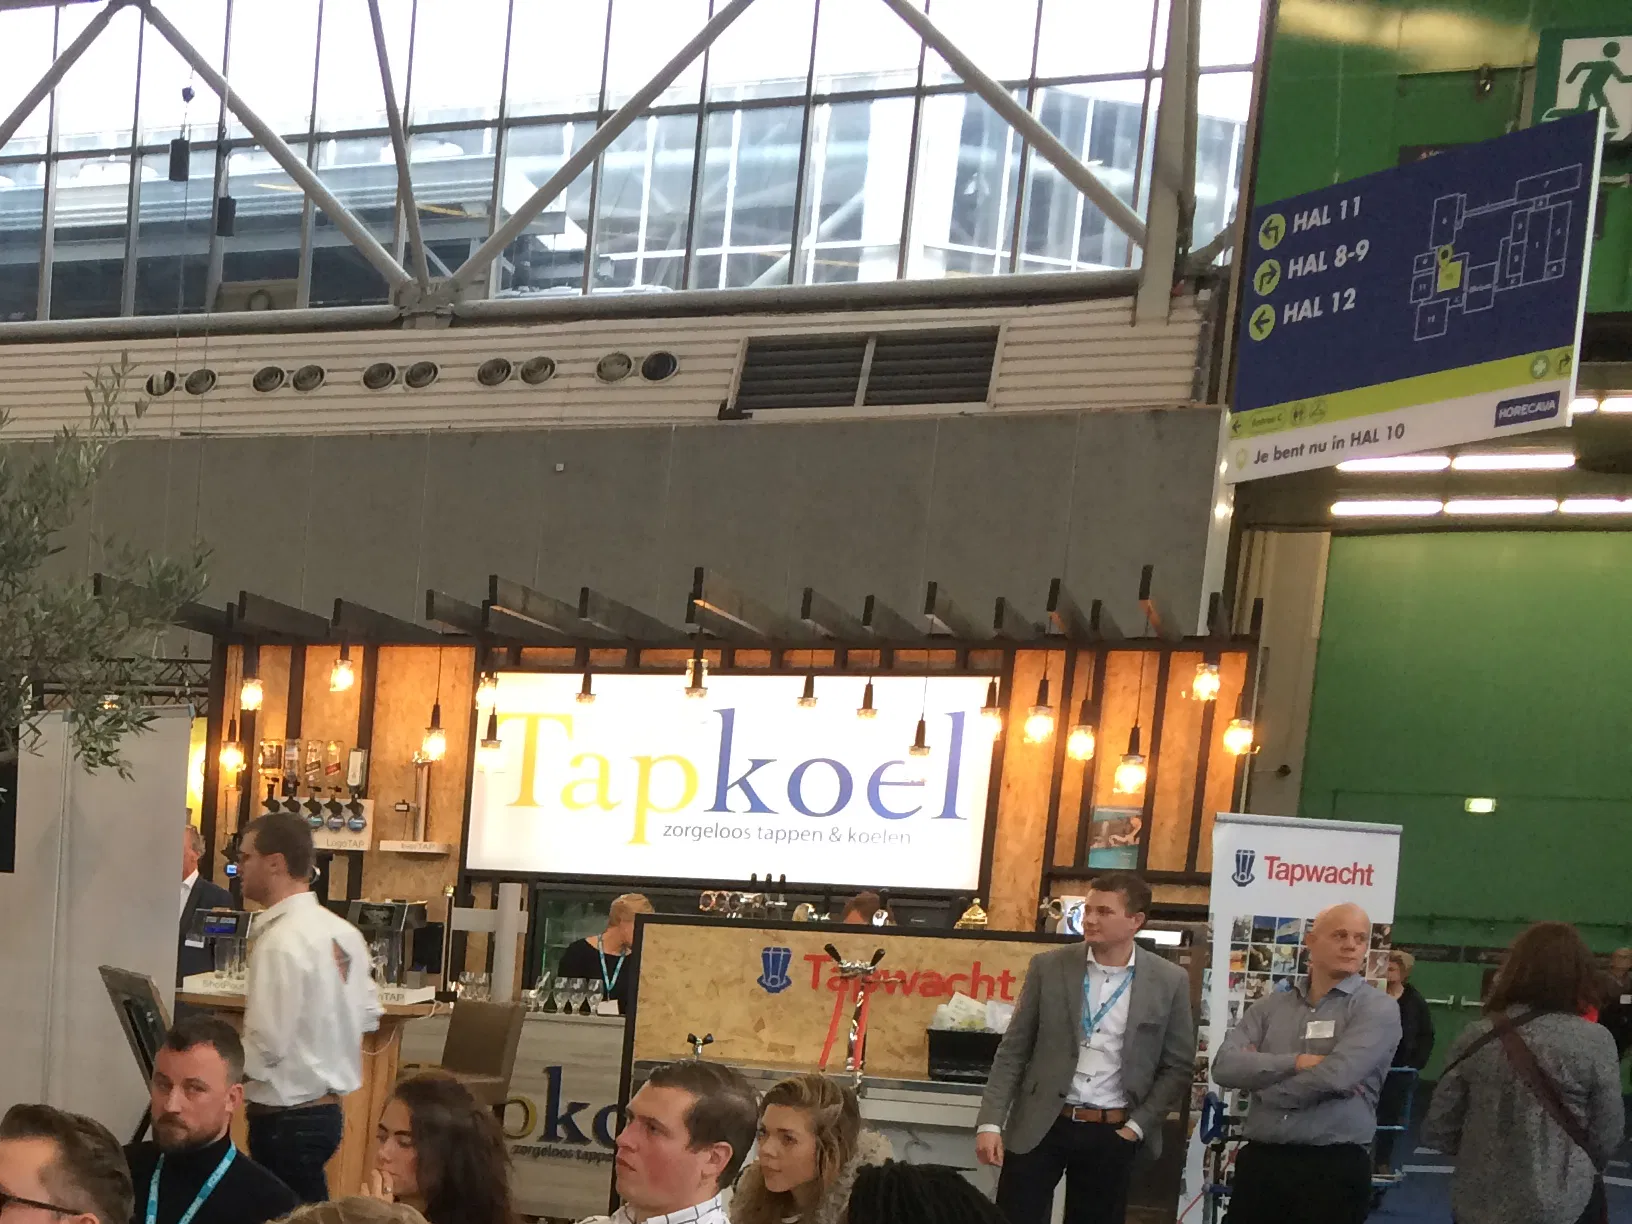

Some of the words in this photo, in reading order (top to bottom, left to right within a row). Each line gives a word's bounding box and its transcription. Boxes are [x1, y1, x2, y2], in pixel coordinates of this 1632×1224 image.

[1292, 204, 1331, 233] HAL
[1340, 196, 1361, 220] 11
[1288, 251, 1328, 279] HAL
[1334, 239, 1370, 268] 8-9
[1283, 296, 1323, 325] HAL
[1332, 287, 1356, 313] 12
[1498, 400, 1556, 419] HORECAVA
[1254, 449, 1268, 464] Je
[1273, 443, 1305, 461] bent
[1309, 440, 1327, 455] nu
[1331, 434, 1345, 451] in
[1350, 428, 1380, 448] HAL
[1387, 422, 1405, 440] 10
[497, 707, 969, 846] Tapkoel
[662, 822, 751, 842] zorgeloos
[757, 826, 823, 844] tappen
[828, 826, 842, 843] &
[847, 826, 911, 845] koelen
[1263, 855, 1375, 887] Tapwacht
